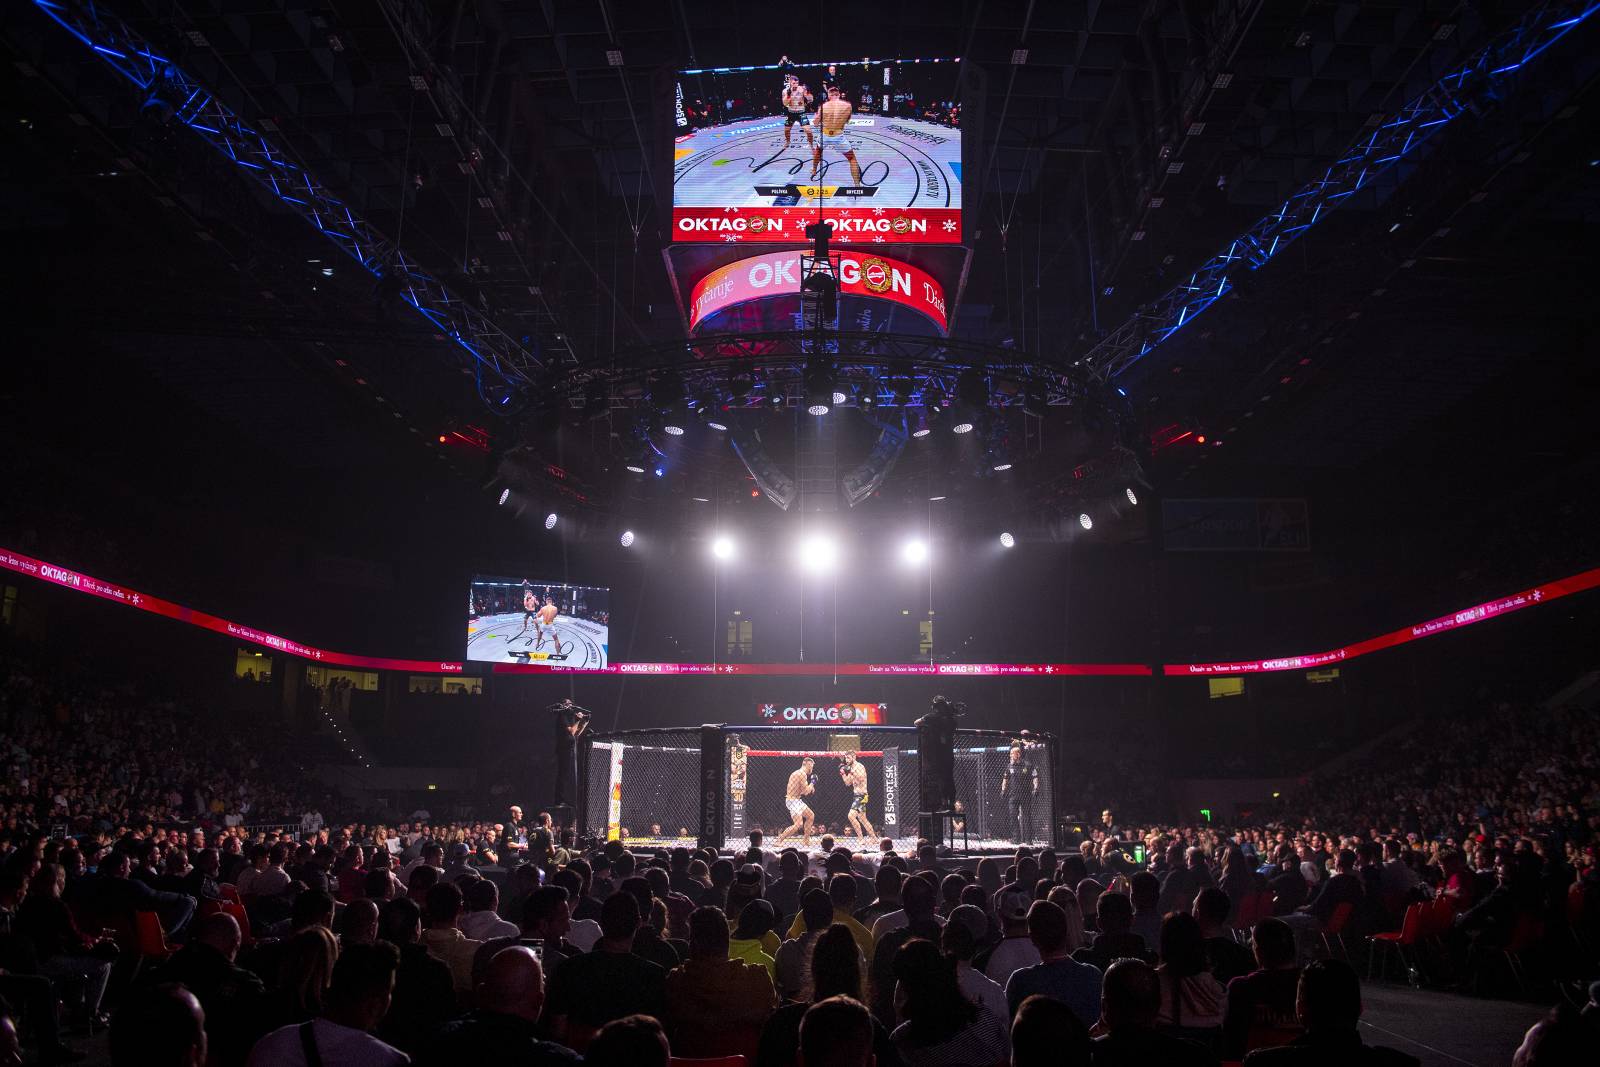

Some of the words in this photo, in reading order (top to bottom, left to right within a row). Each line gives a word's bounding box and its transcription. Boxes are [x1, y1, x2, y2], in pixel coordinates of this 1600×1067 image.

[679, 216, 783, 233] OKTAGON
[41, 565, 80, 586] OKTAGON
[783, 705, 868, 722] OKTAGON
[706, 769, 716, 836] OKTAGN
